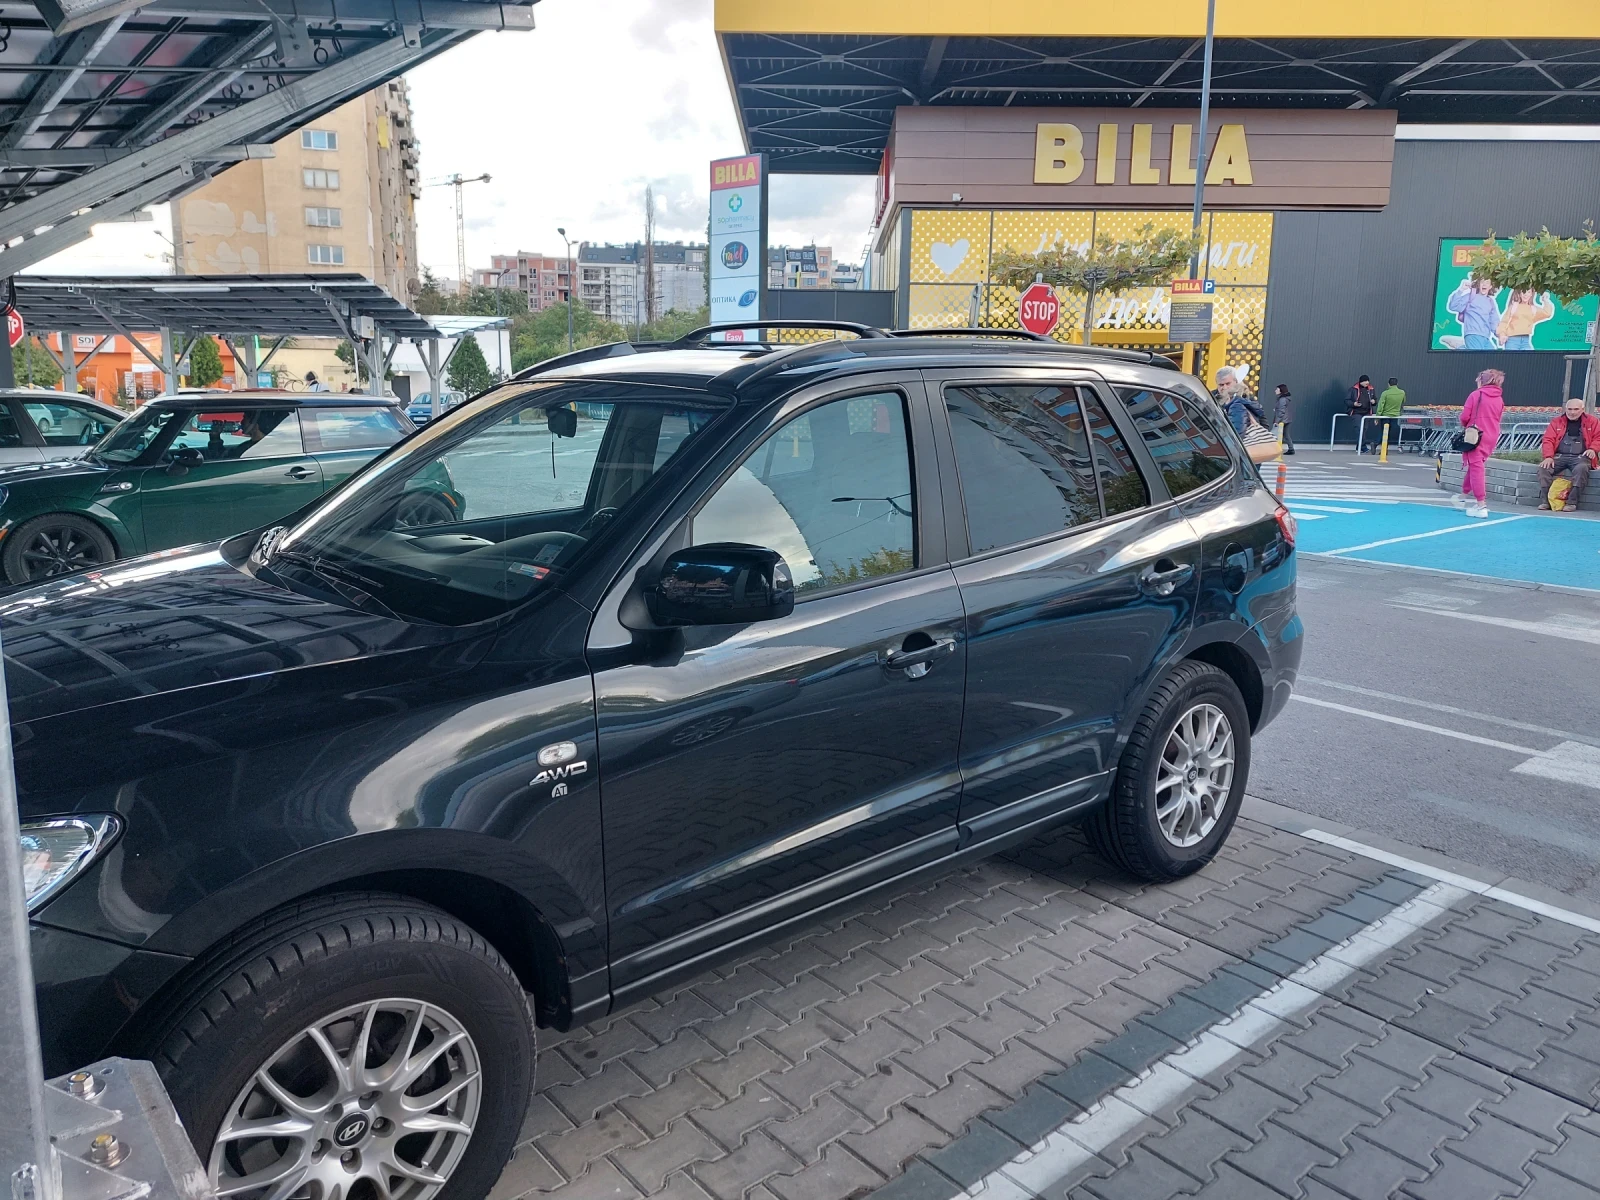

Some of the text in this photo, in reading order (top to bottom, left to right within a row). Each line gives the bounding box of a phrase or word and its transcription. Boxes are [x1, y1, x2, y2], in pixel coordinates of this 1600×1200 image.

[1033, 123, 1253, 185] BILLA
[715, 162, 757, 184] BILLA
[1174, 281, 1213, 292] BILLA P
[1024, 301, 1056, 320] STOP
[726, 333, 743, 342] Easy
[529, 761, 588, 786] 4WD
